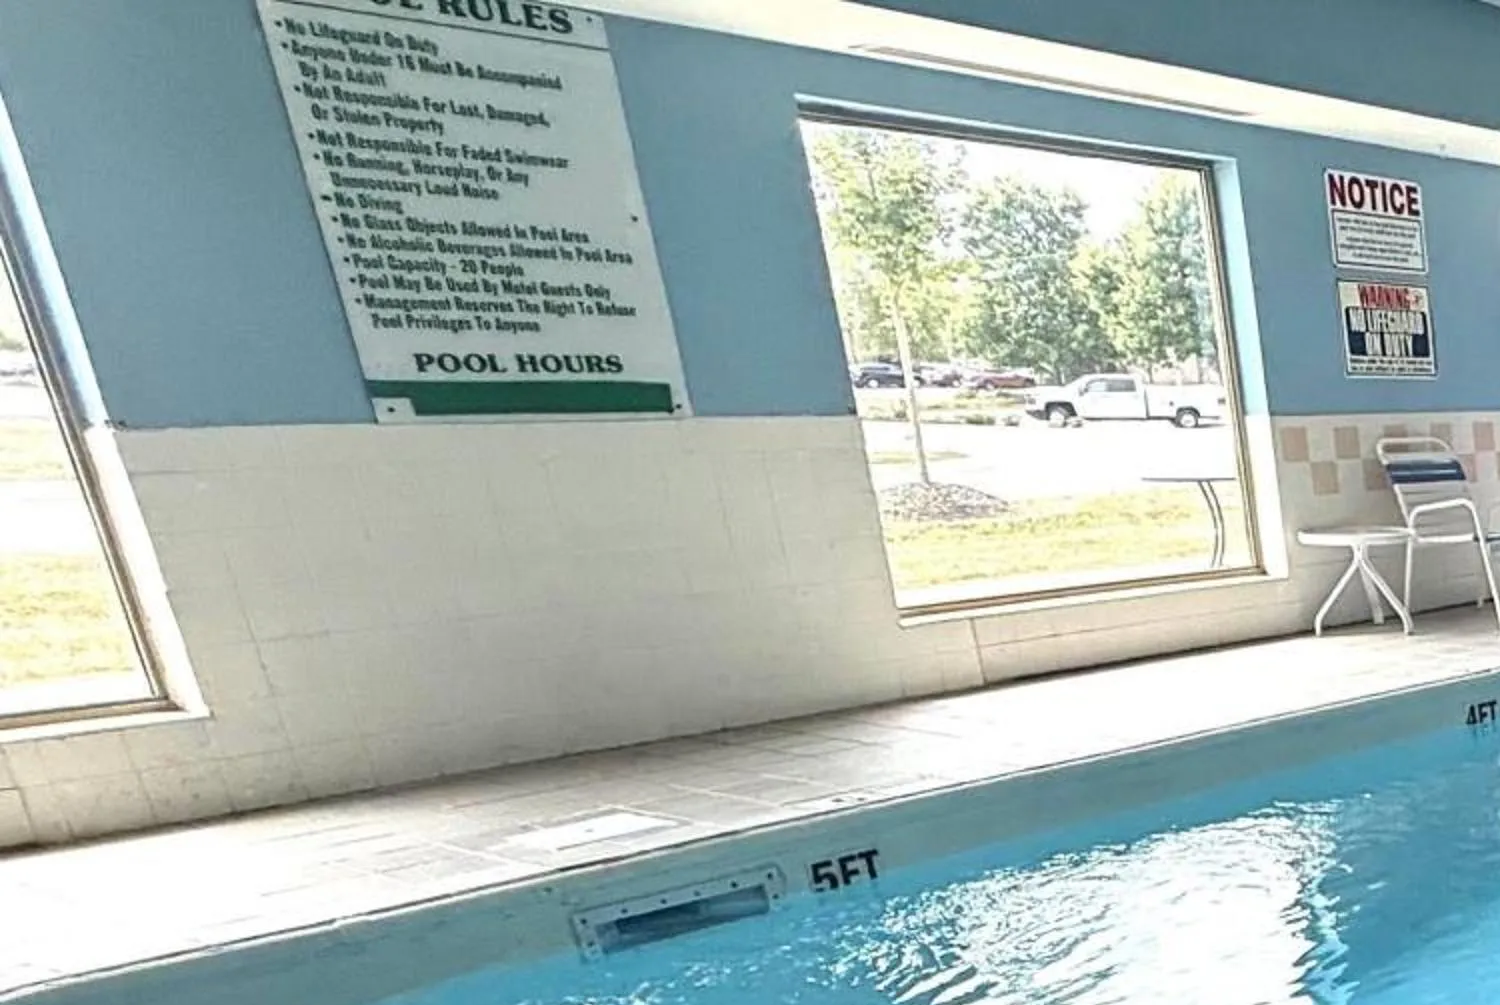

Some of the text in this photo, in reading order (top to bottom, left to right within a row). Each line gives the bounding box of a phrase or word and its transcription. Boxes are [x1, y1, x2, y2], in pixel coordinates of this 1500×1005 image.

[437, 0, 574, 34] RULES
[283, 17, 438, 56] No Lifeguard On Duty
[292, 39, 346, 61] Anyone
[349, 48, 392, 66] Under
[418, 56, 452, 75] Must
[454, 61, 474, 77] Be
[477, 64, 563, 90] Accompanied
[299, 61, 386, 87] By An Adult
[303, 82, 329, 99] Not
[332, 85, 420, 110] Responsible
[423, 96, 446, 113] For
[311, 103, 444, 136] Or Stolen Property
[316, 129, 569, 168] Not Responsible For Faded Swimwear
[323, 151, 343, 167] No
[486, 165, 502, 181] Or
[505, 167, 529, 188] Any
[330, 171, 499, 200] Unnecessary Loud Noise
[1328, 173, 1421, 217] NOTICE
[334, 192, 404, 214] No Diving
[340, 212, 589, 243] No Glass Objects Allowed In Pool Area
[345, 233, 633, 264] No Alcoholic Beverages Allowed In Pool Area
[352, 253, 384, 269] Pool
[387, 254, 447, 275] Capacity
[459, 259, 478, 274] 20
[480, 260, 525, 278] People
[358, 273, 389, 289] Pool
[392, 275, 421, 293] May
[424, 276, 443, 291] Be
[445, 276, 479, 292] Used
[482, 278, 498, 296] By
[540, 281, 582, 297] Guests
[584, 283, 611, 300] Only
[363, 293, 637, 318] Management Reserves The Right To Refuse
[371, 313, 541, 334] Pool Privileges To Anyone
[413, 353, 624, 373] POOL HOURS
[1465, 699, 1498, 725] 4FT
[811, 848, 879, 892] 5FT
